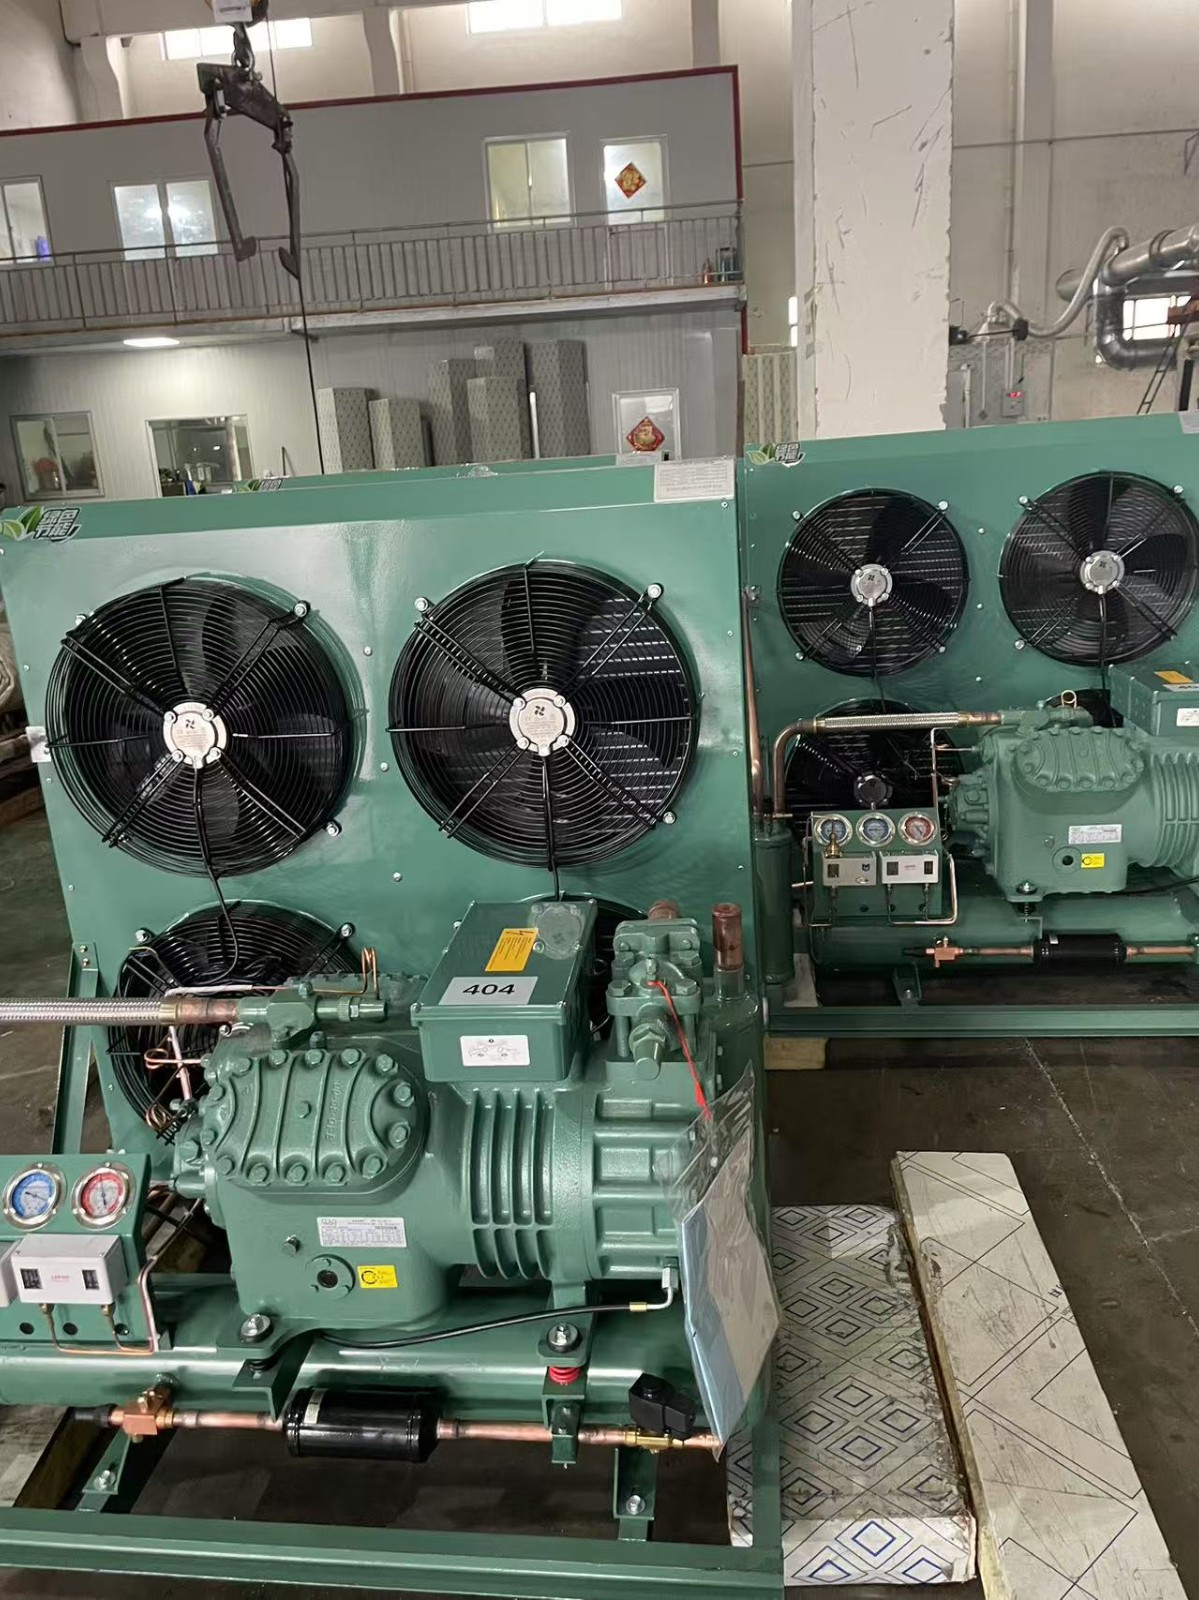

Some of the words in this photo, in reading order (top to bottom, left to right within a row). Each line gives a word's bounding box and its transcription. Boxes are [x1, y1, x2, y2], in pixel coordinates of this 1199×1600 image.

[40, 509, 79, 525] 绿色
[36, 522, 72, 538] 节能
[462, 983, 516, 995] 404
